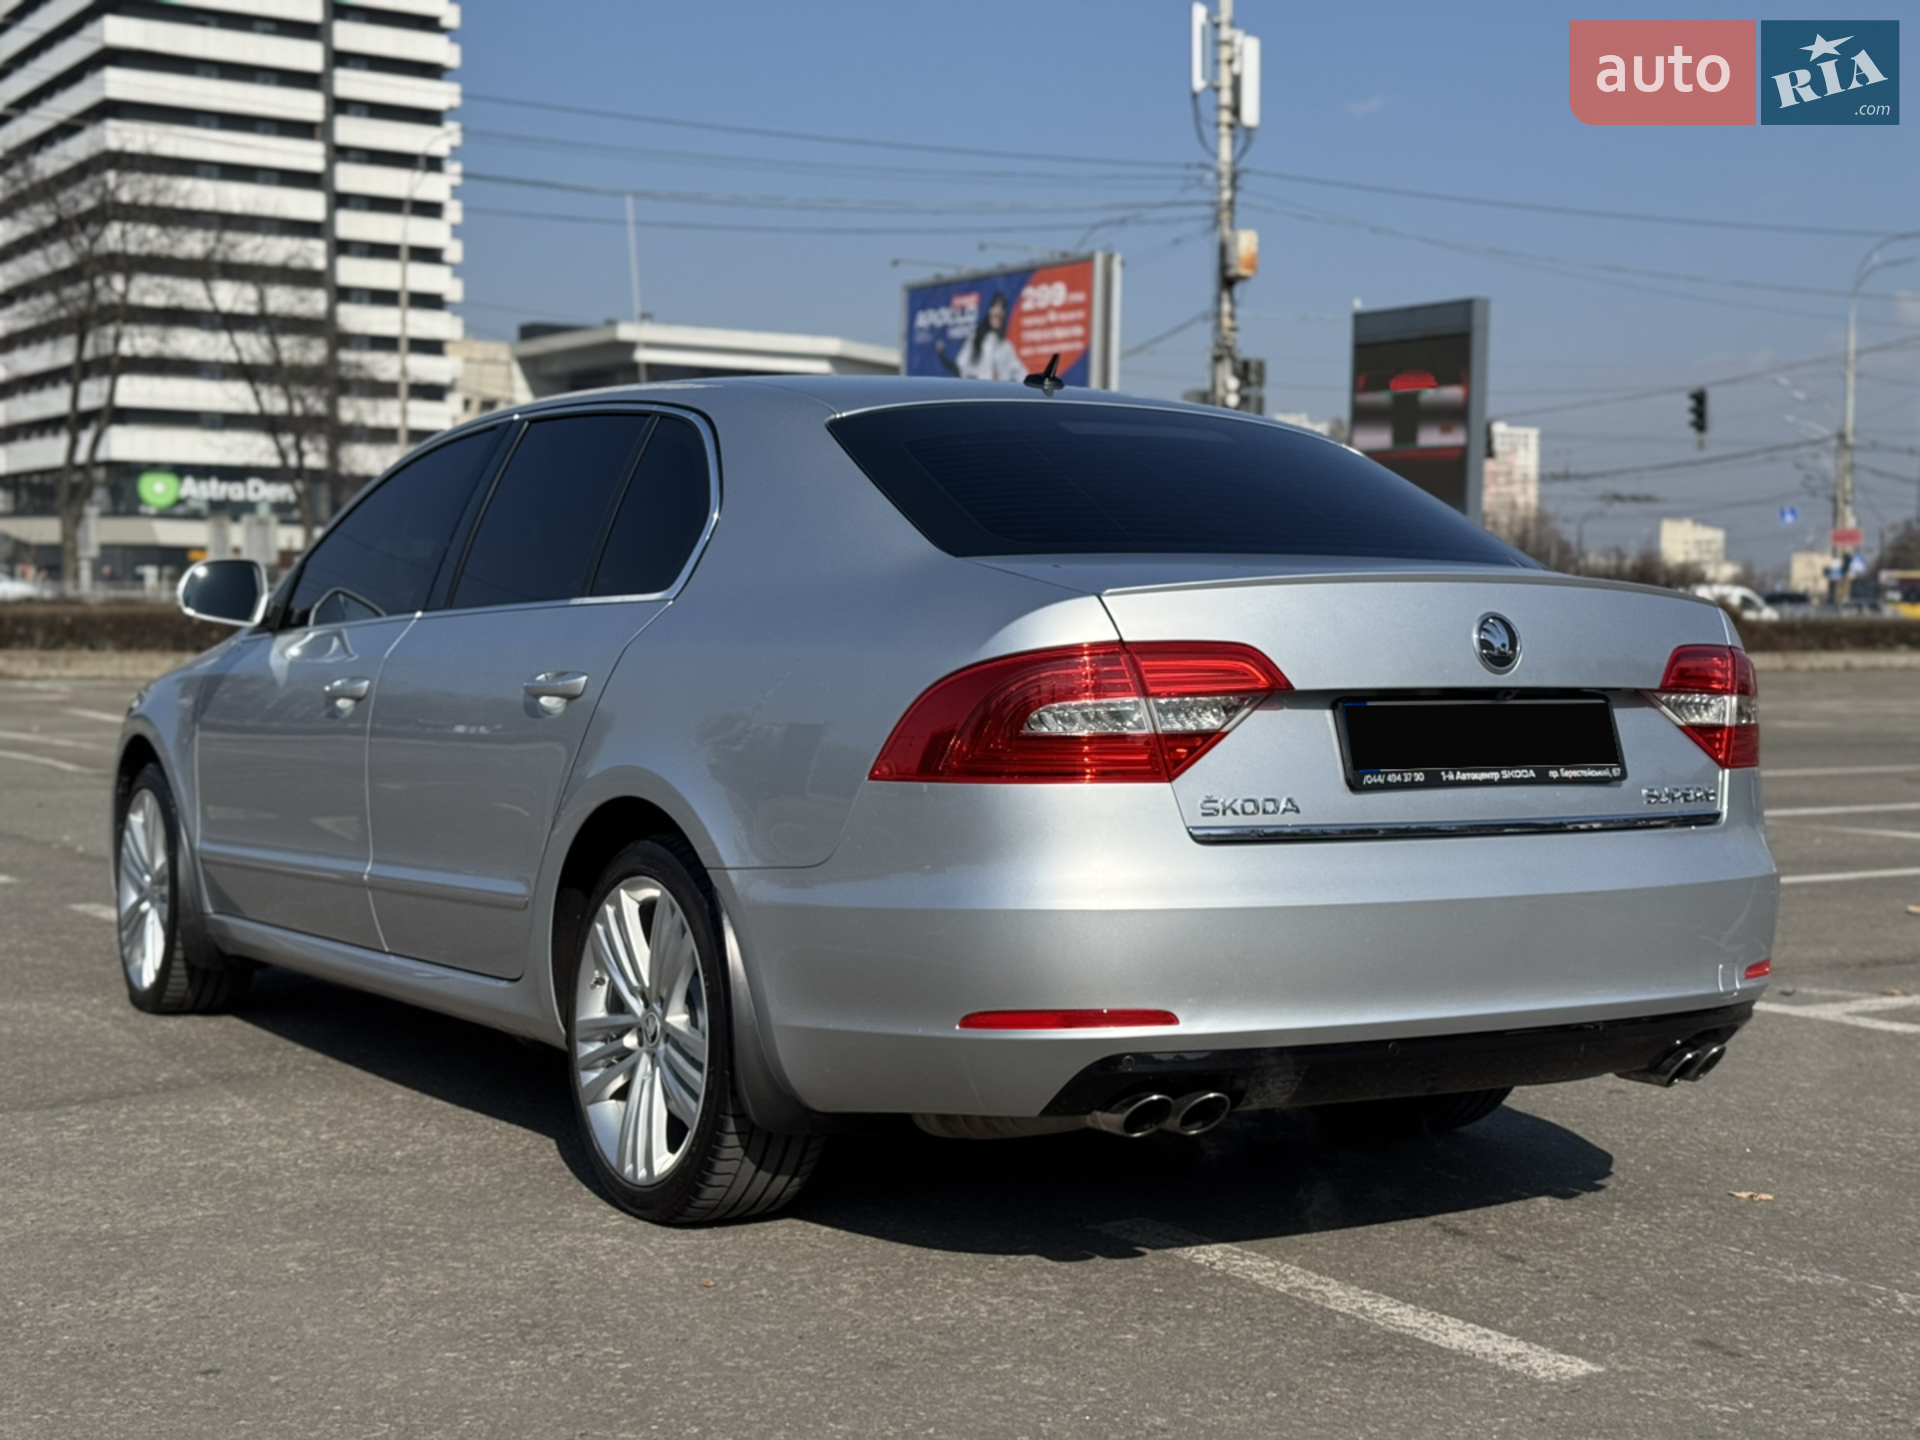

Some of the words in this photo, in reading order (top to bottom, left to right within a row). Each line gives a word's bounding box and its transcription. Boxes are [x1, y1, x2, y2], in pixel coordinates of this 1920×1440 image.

[1020, 281, 1068, 311] 299
[1403, 772, 1412, 783] 37
[1455, 770, 1500, 782] Автоцентр
[1641, 785, 1717, 805] SUPERB
[1200, 795, 1301, 817] ŠKODA
